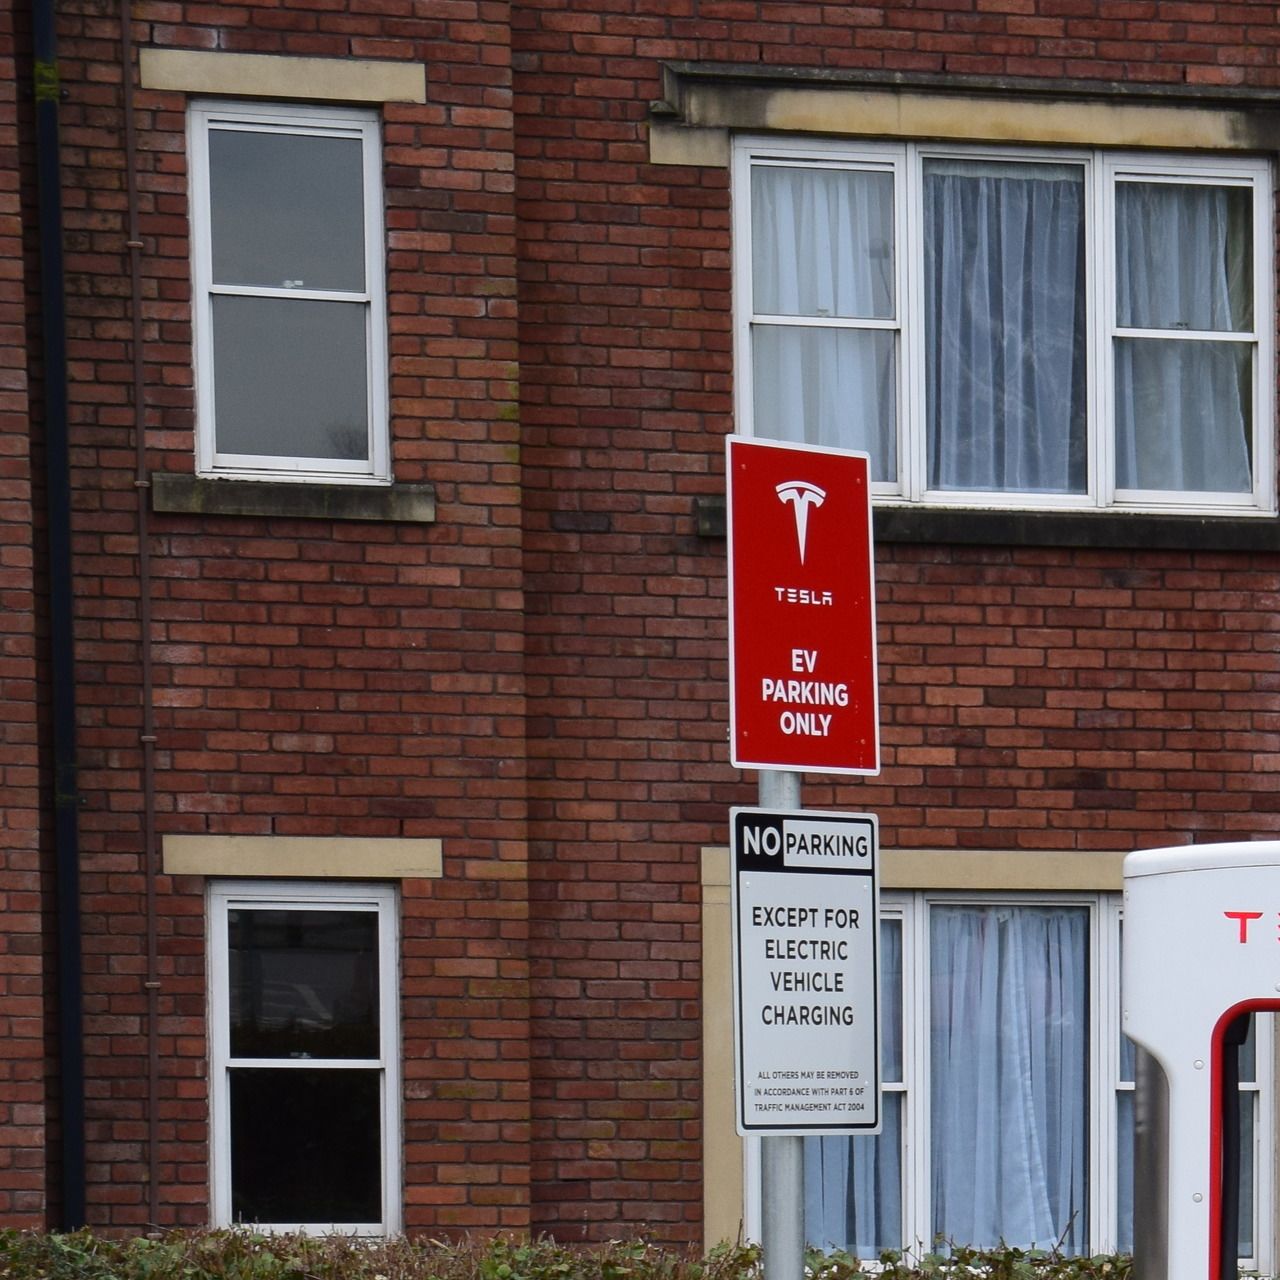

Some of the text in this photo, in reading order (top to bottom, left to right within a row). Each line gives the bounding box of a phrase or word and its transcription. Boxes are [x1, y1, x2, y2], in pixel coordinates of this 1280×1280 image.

[774, 586, 833, 606] TESLA
[791, 648, 818, 674] EV
[761, 678, 849, 707] PARKING
[779, 711, 833, 737] ONLY
[742, 825, 868, 858] NO PARKING
[752, 906, 860, 929] EXCEPT FOR
[765, 939, 849, 961] ELECTRIC
[770, 971, 845, 993] VEHICLE
[761, 1004, 854, 1026] CHARGING
[757, 1070, 860, 1080] ALL OTHERS MAY BE REMOVED
[754, 1087, 762, 1097] IN
[762, 1087, 810, 1097] ACCORDANCE
[810, 1087, 830, 1097] WITH
[830, 1087, 849, 1097] PART
[854, 1087, 865, 1097] OF
[754, 1102, 865, 1112] TRAFFIC MANAGEMENT ACT 2004
